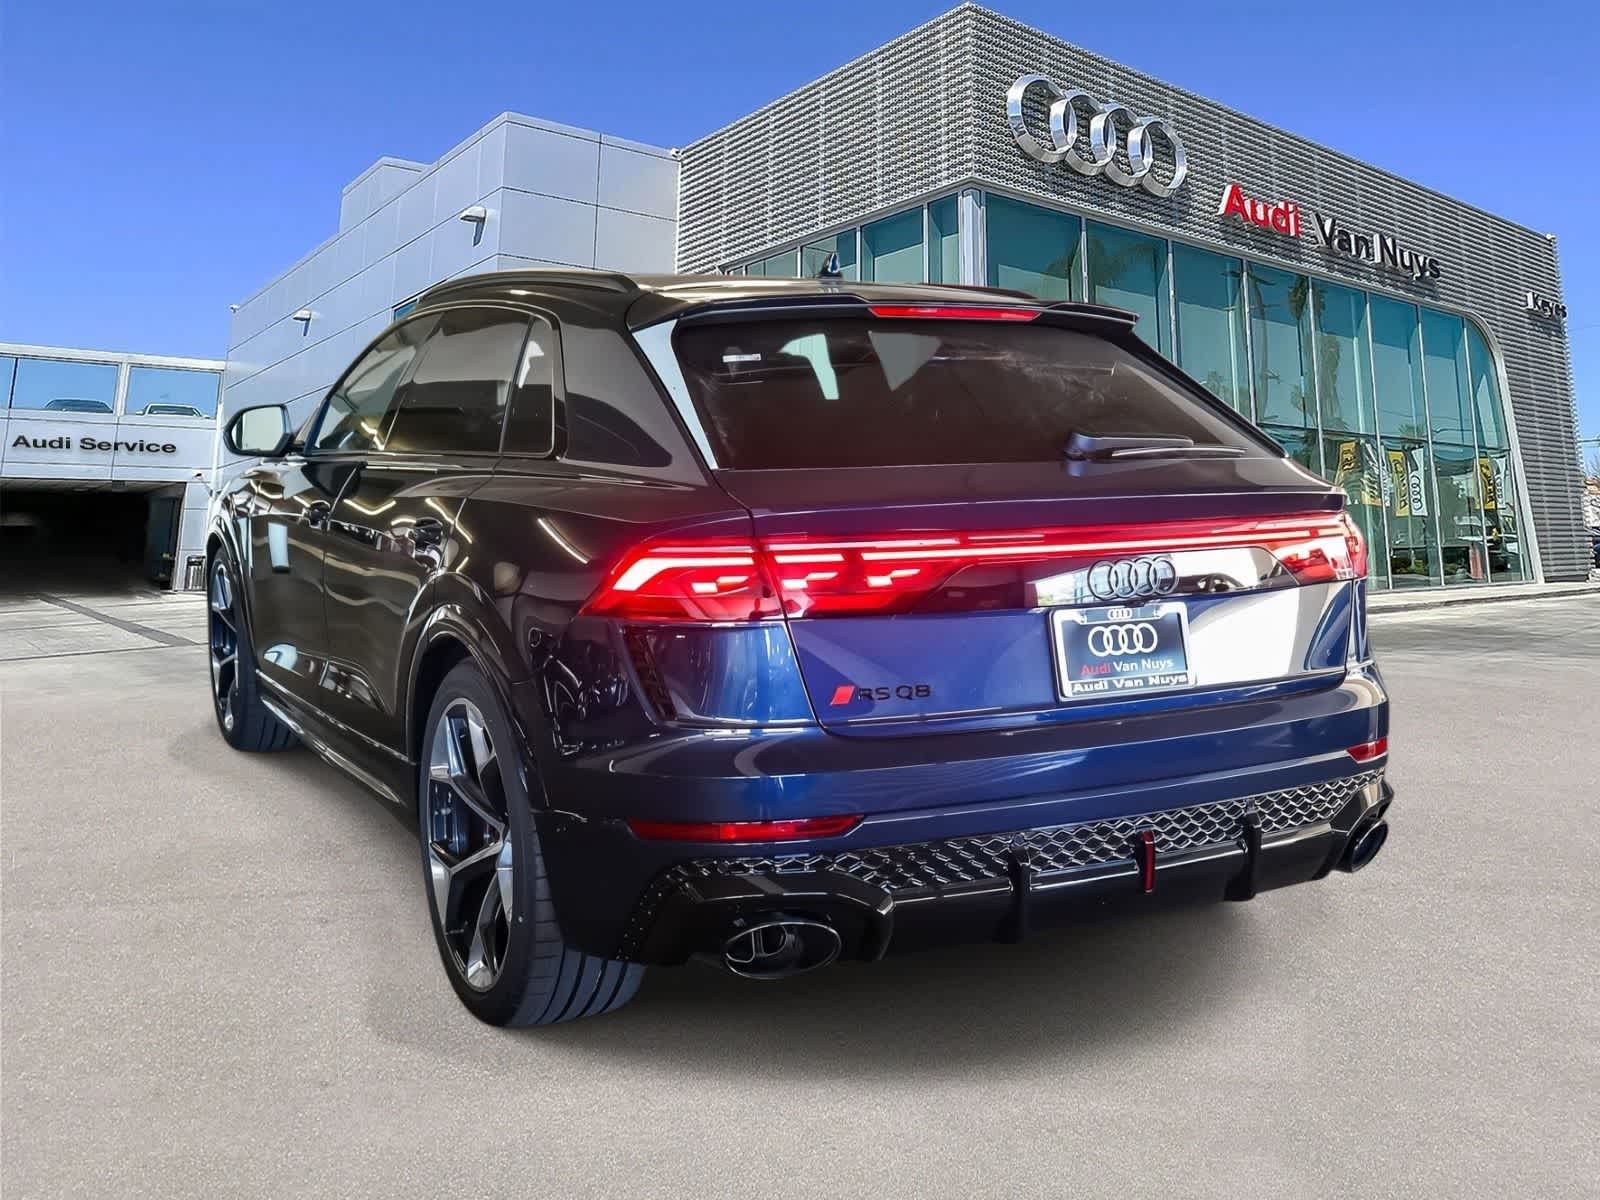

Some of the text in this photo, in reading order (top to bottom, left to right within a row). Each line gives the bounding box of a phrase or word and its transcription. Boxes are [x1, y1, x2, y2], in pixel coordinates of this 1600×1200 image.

[1217, 182, 1442, 281] Audi Van Nuys
[11, 434, 177, 454] Audi Service
[1080, 657, 1174, 676] Audi Van Nuys
[858, 684, 932, 701] RS Q8
[1072, 674, 1187, 693] Audi Van Nuys
